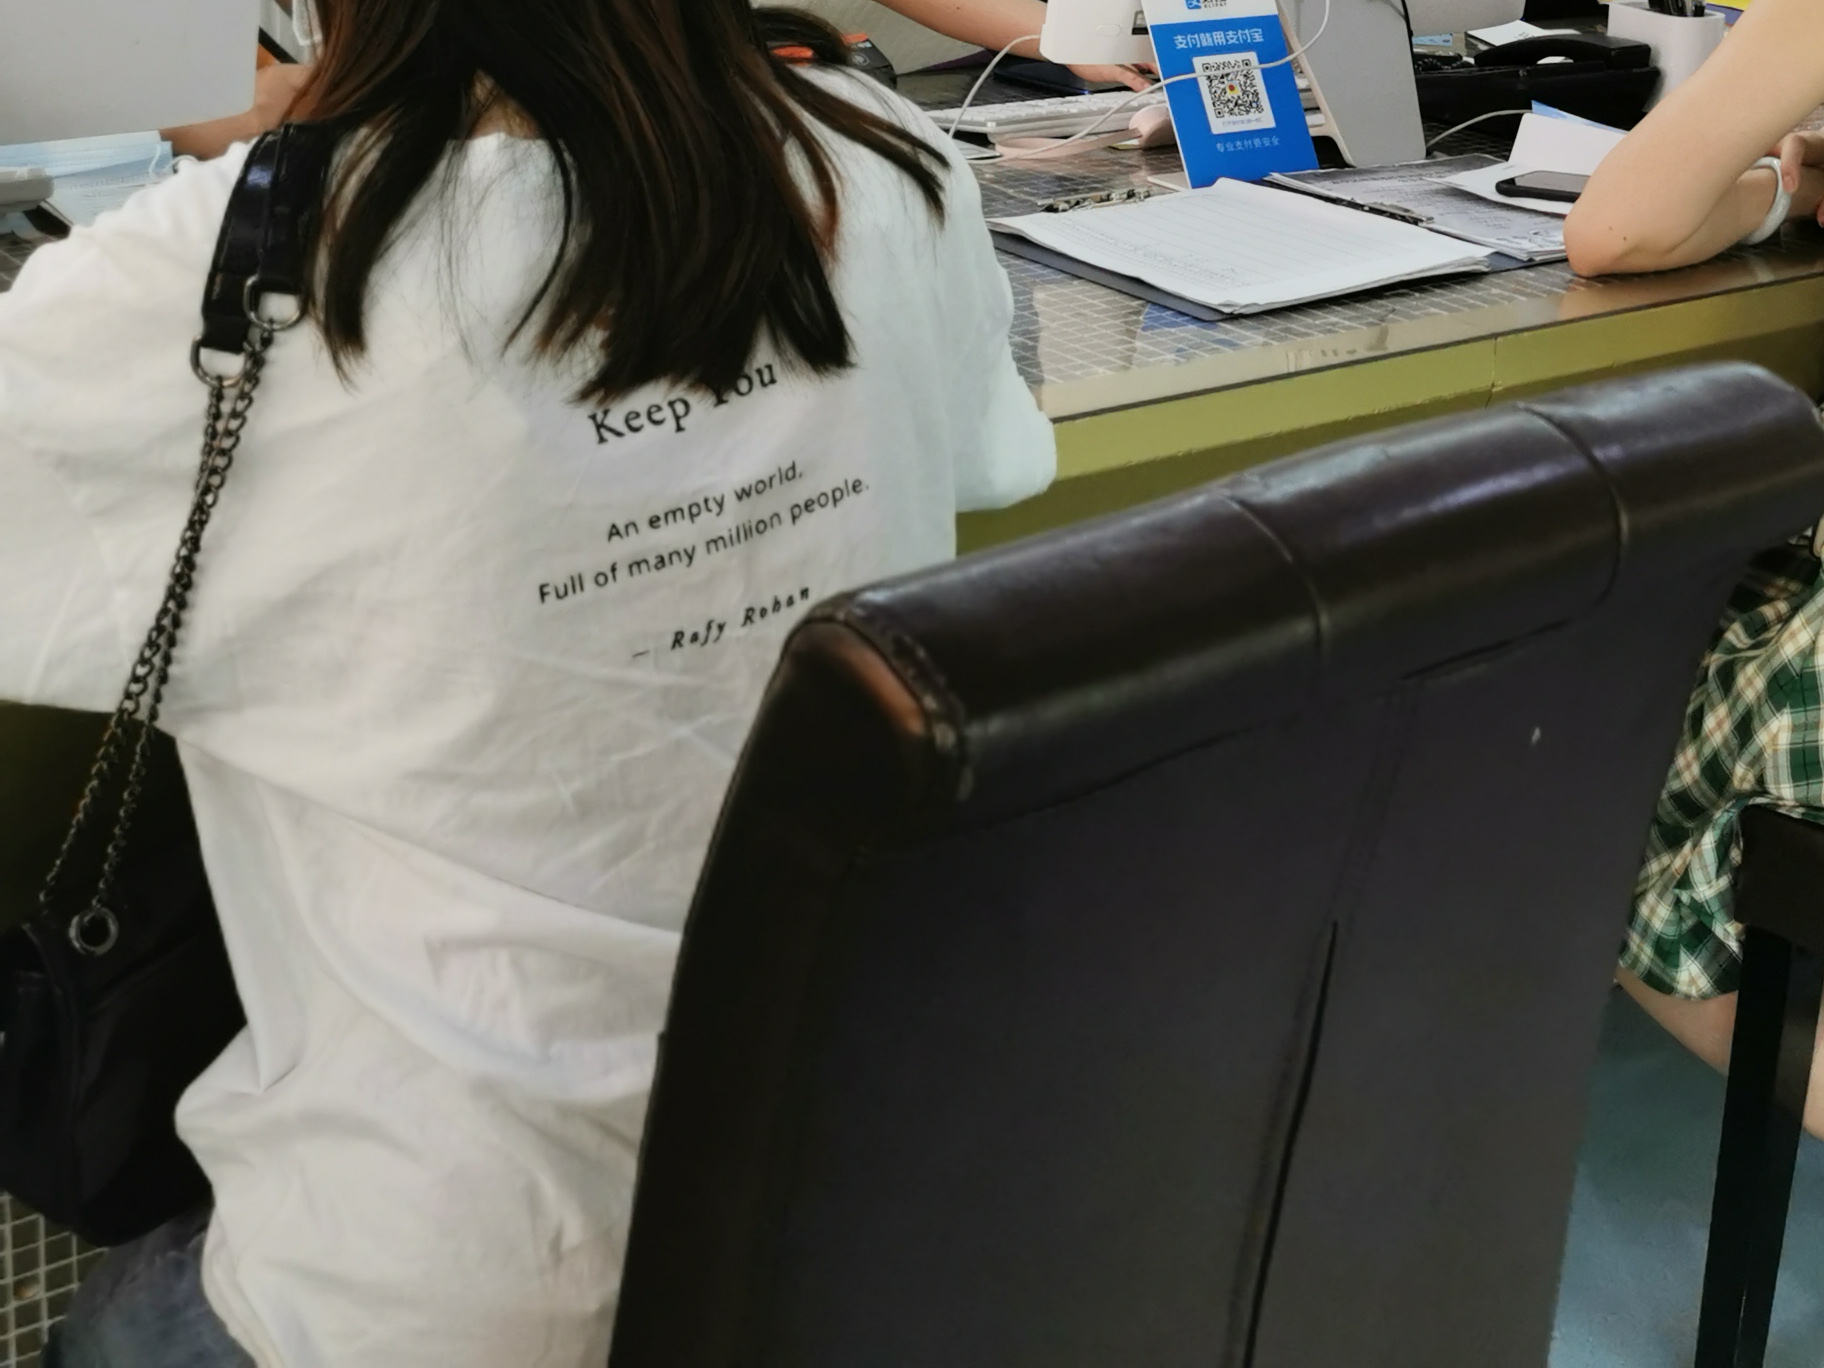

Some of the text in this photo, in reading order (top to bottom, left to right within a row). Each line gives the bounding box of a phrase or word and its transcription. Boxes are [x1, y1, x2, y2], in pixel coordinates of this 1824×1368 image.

[1173, 28, 1265, 49] 支付就用支付宝
[587, 395, 692, 445] Keep
[538, 476, 871, 604] Full of many million people.
[606, 518, 639, 543] An
[648, 493, 726, 531] empty
[670, 618, 727, 650] Rafy
[741, 585, 811, 628] Rohan
